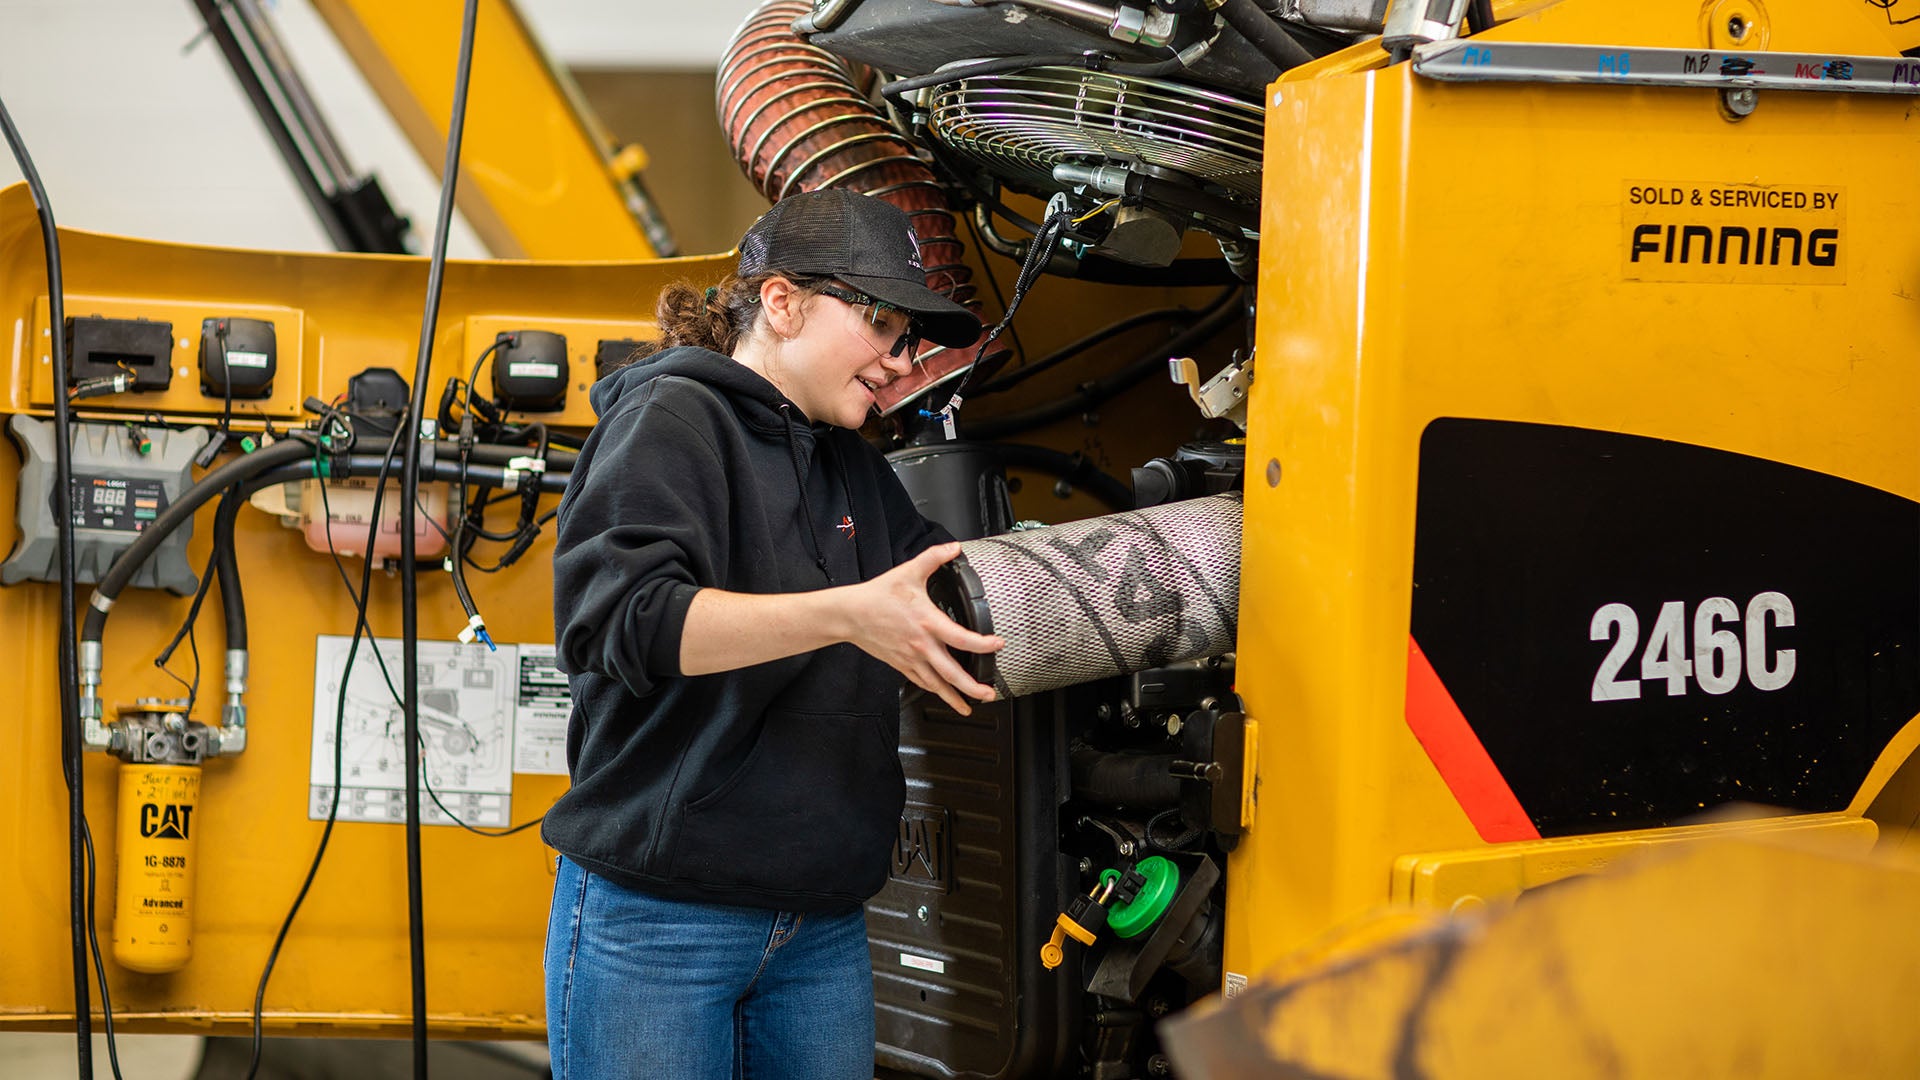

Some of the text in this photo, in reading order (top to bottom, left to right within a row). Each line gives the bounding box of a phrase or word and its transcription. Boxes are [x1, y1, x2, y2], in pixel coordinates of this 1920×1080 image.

[1462, 47, 1491, 66] MA
[1599, 53, 1631, 76] MB
[1684, 53, 1710, 74] MB
[1794, 63, 1820, 79] MC
[1630, 187, 1839, 210] SOLD & SERVICED BY
[1630, 224, 1839, 267] FINNING
[1590, 591, 1796, 702] 246C
[140, 803, 193, 840] CAT
[144, 855, 186, 868] 1G-8878
[143, 898, 183, 909] Advanced
